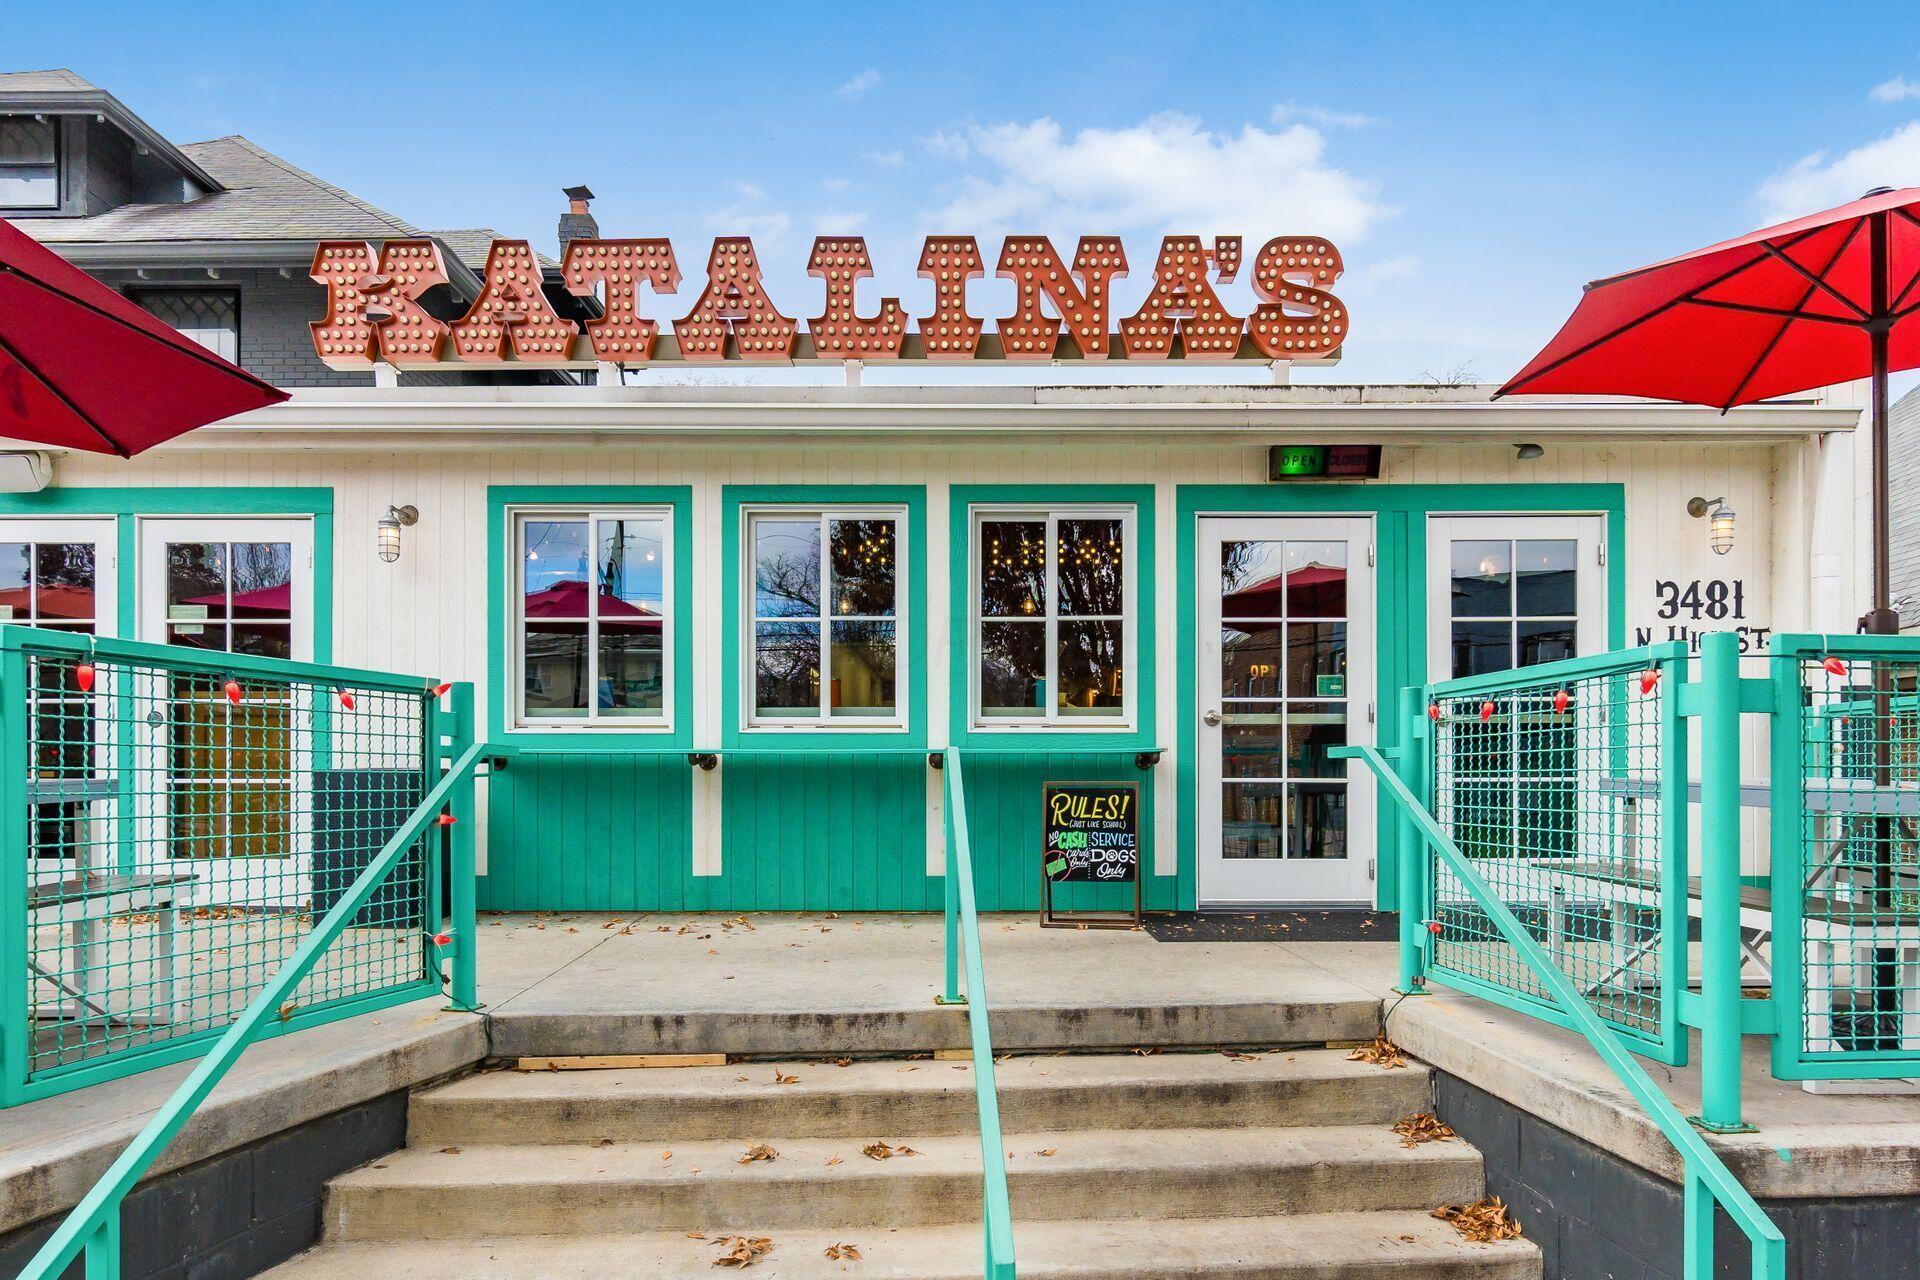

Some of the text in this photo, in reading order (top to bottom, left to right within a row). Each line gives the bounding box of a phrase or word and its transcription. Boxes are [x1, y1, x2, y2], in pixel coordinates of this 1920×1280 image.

[309, 235, 1350, 366] KATALINA'S
[1282, 454, 1316, 467] OPEN
[1655, 579, 1746, 620] 3481
[1050, 793, 1130, 826] RULES!
[1069, 820, 1127, 830] (JUST LIKE SCHOOL)
[1058, 831, 1088, 850] CASH
[1091, 831, 1135, 847] SERVICE
[1070, 857, 1088, 868] Only
[1090, 849, 1136, 864] DOGS
[1096, 862, 1127, 878] Only
